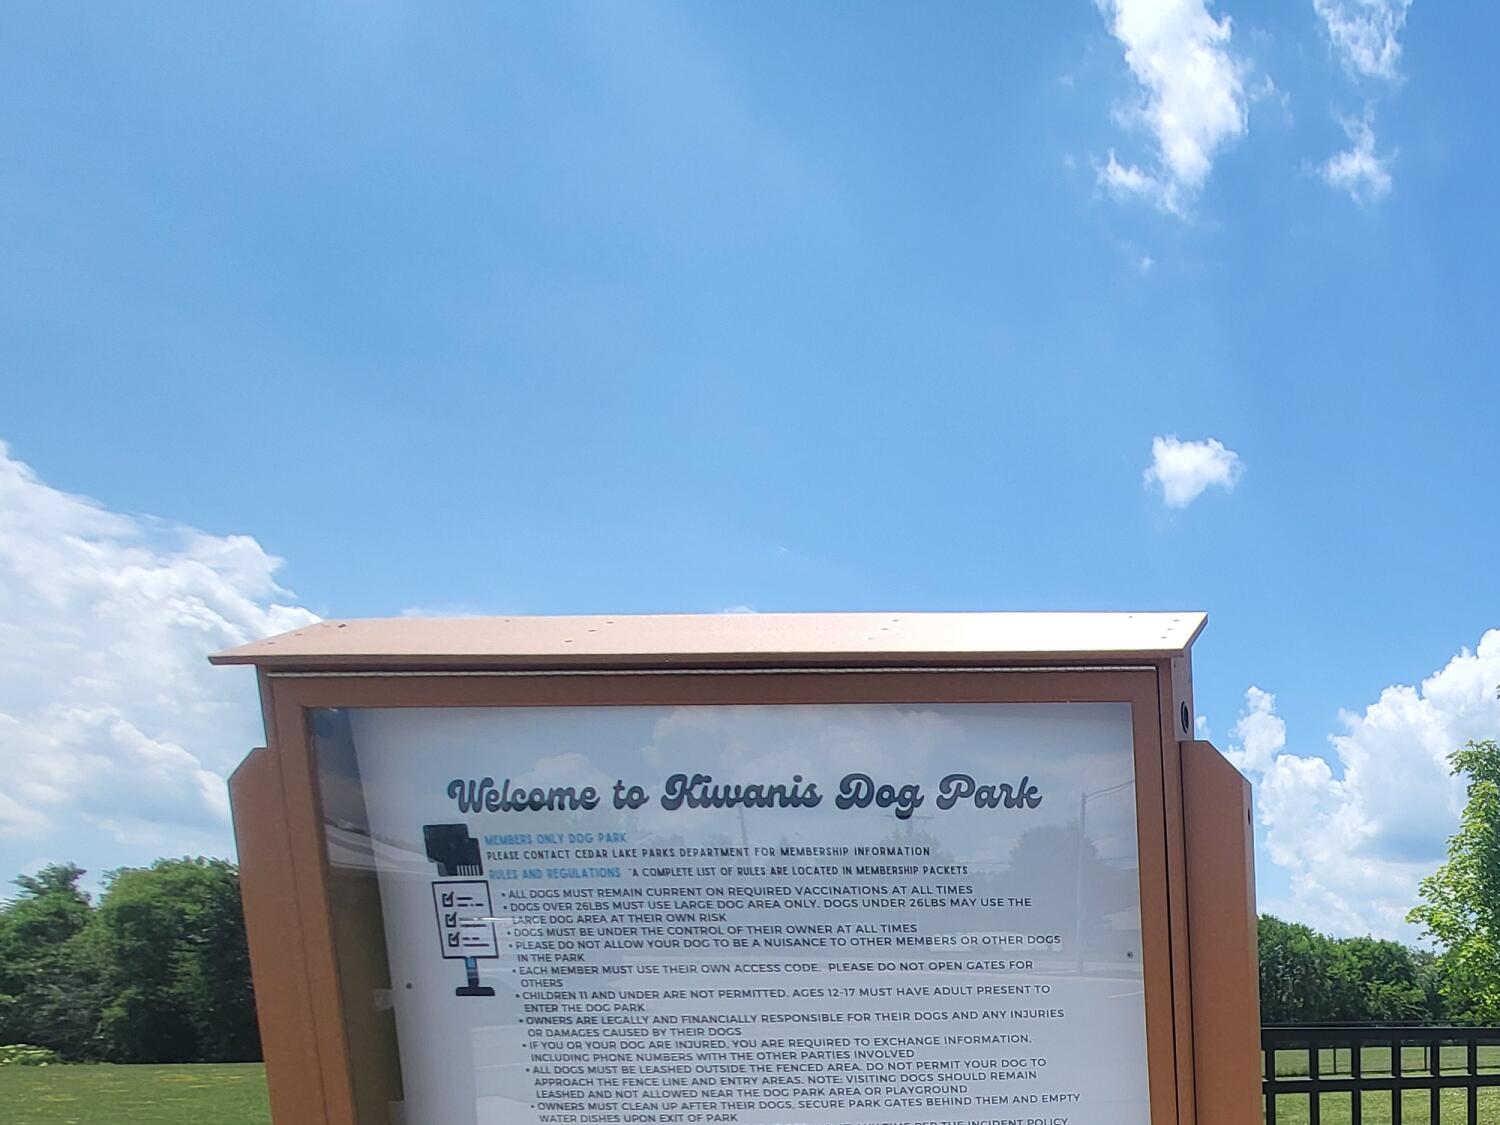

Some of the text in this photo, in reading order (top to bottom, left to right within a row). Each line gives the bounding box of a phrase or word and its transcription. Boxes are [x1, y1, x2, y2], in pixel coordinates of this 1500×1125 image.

[447, 773, 1043, 820] Welcome to Kiwanis Dog Park
[484, 832, 627, 846] MEMBERS ONLY DOG PARK
[486, 846, 930, 861] PLEASE CONTACT CEDAR LAKE PARKS DEPARTMENT FOR MEMBERSHIP INFORMATION
[489, 869, 518, 880] RULES
[522, 869, 543, 879] AND
[546, 867, 621, 879] REGULATIONS
[642, 867, 694, 877] COMPLETE
[696, 867, 716, 877] LIST
[720, 866, 732, 876] OF
[737, 866, 766, 876] RULES
[770, 866, 789, 876] ARE
[792, 866, 838, 876] LOCATED
[842, 866, 852, 875] IN
[856, 865, 919, 875] MEMBERSHIP
[923, 865, 968, 875] PACKETS
[508, 885, 973, 900] ALL DOGS MUST REMAIN CURRENT ON REQUIRED VACCINATIONS AT ALL TIMES
[510, 897, 1032, 915] DOGS OVER 26LBS MUST USE LARGE DOG AREA ONLY. DOGS UNDER 26LBS MAY USE THE
[514, 923, 917, 937] DOGS MUST BE UNDER THE CONTROL OF THEIR OWNER AT ALL TIMES
[515, 935, 1061, 950] PLEASE DO NOT ALLOW YOUR DOG TO BE A NUISANCE TO OTHER MEMBERS OR OTHER DOGS
[517, 953, 585, 963] IN THE PARK
[522, 991, 577, 1000] CHILDREN
[591, 991, 616, 1000] AND
[618, 990, 660, 1000] UNDER
[663, 990, 687, 999] ARE
[690, 989, 714, 999] NOT
[718, 989, 789, 999] PERMITTED.
[792, 988, 824, 998] AGES
[828, 987, 855, 997] 12-17
[859, 987, 891, 997] MUST
[896, 987, 930, 996] HAVE
[933, 986, 971, 996] ADULT
[977, 985, 1029, 995] PRESENT
[1036, 985, 1050, 994] TO
[527, 1027, 742, 1038] OR DAMAGES CAUSED BY THEIR DOGS
[531, 1049, 915, 1062] INCLUDING PHONE NUMBERS WITH THE OTHER PARTIES INVOLVED
[536, 1084, 968, 1099] LEASHED AND NOT ALLOWED NEAR THE DOG PARK AREA OR PLAYGROUND
